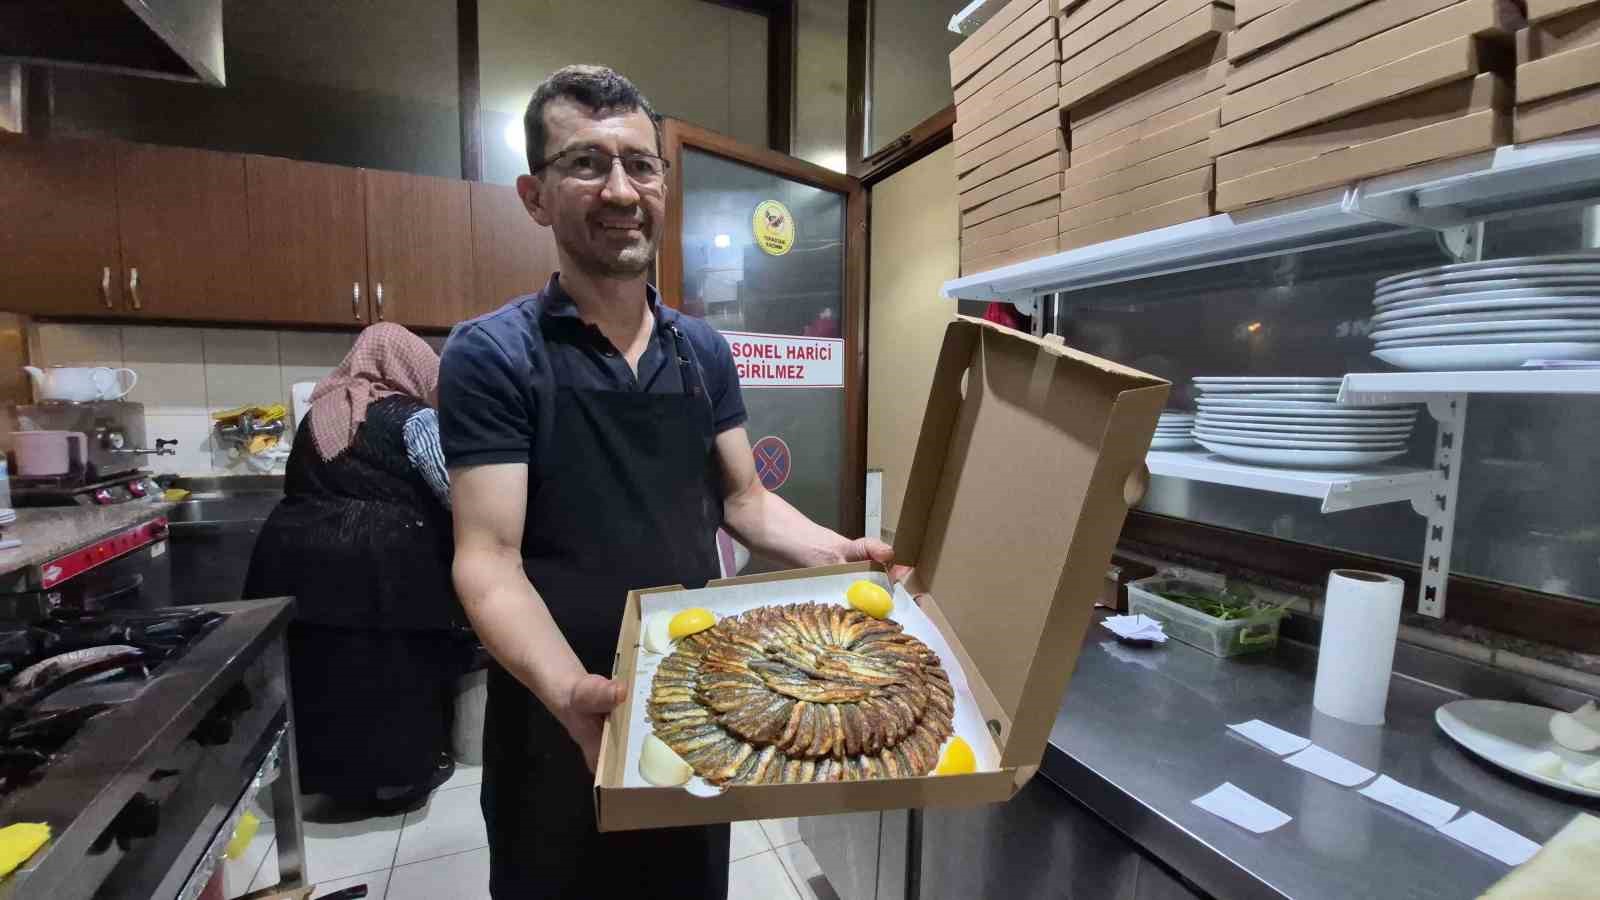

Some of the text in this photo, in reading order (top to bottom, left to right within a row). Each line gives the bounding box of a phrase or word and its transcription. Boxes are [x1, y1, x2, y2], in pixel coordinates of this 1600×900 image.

[732, 342, 832, 361] SONEL HARİCİ
[736, 360, 804, 379] GİRİLMEZ
